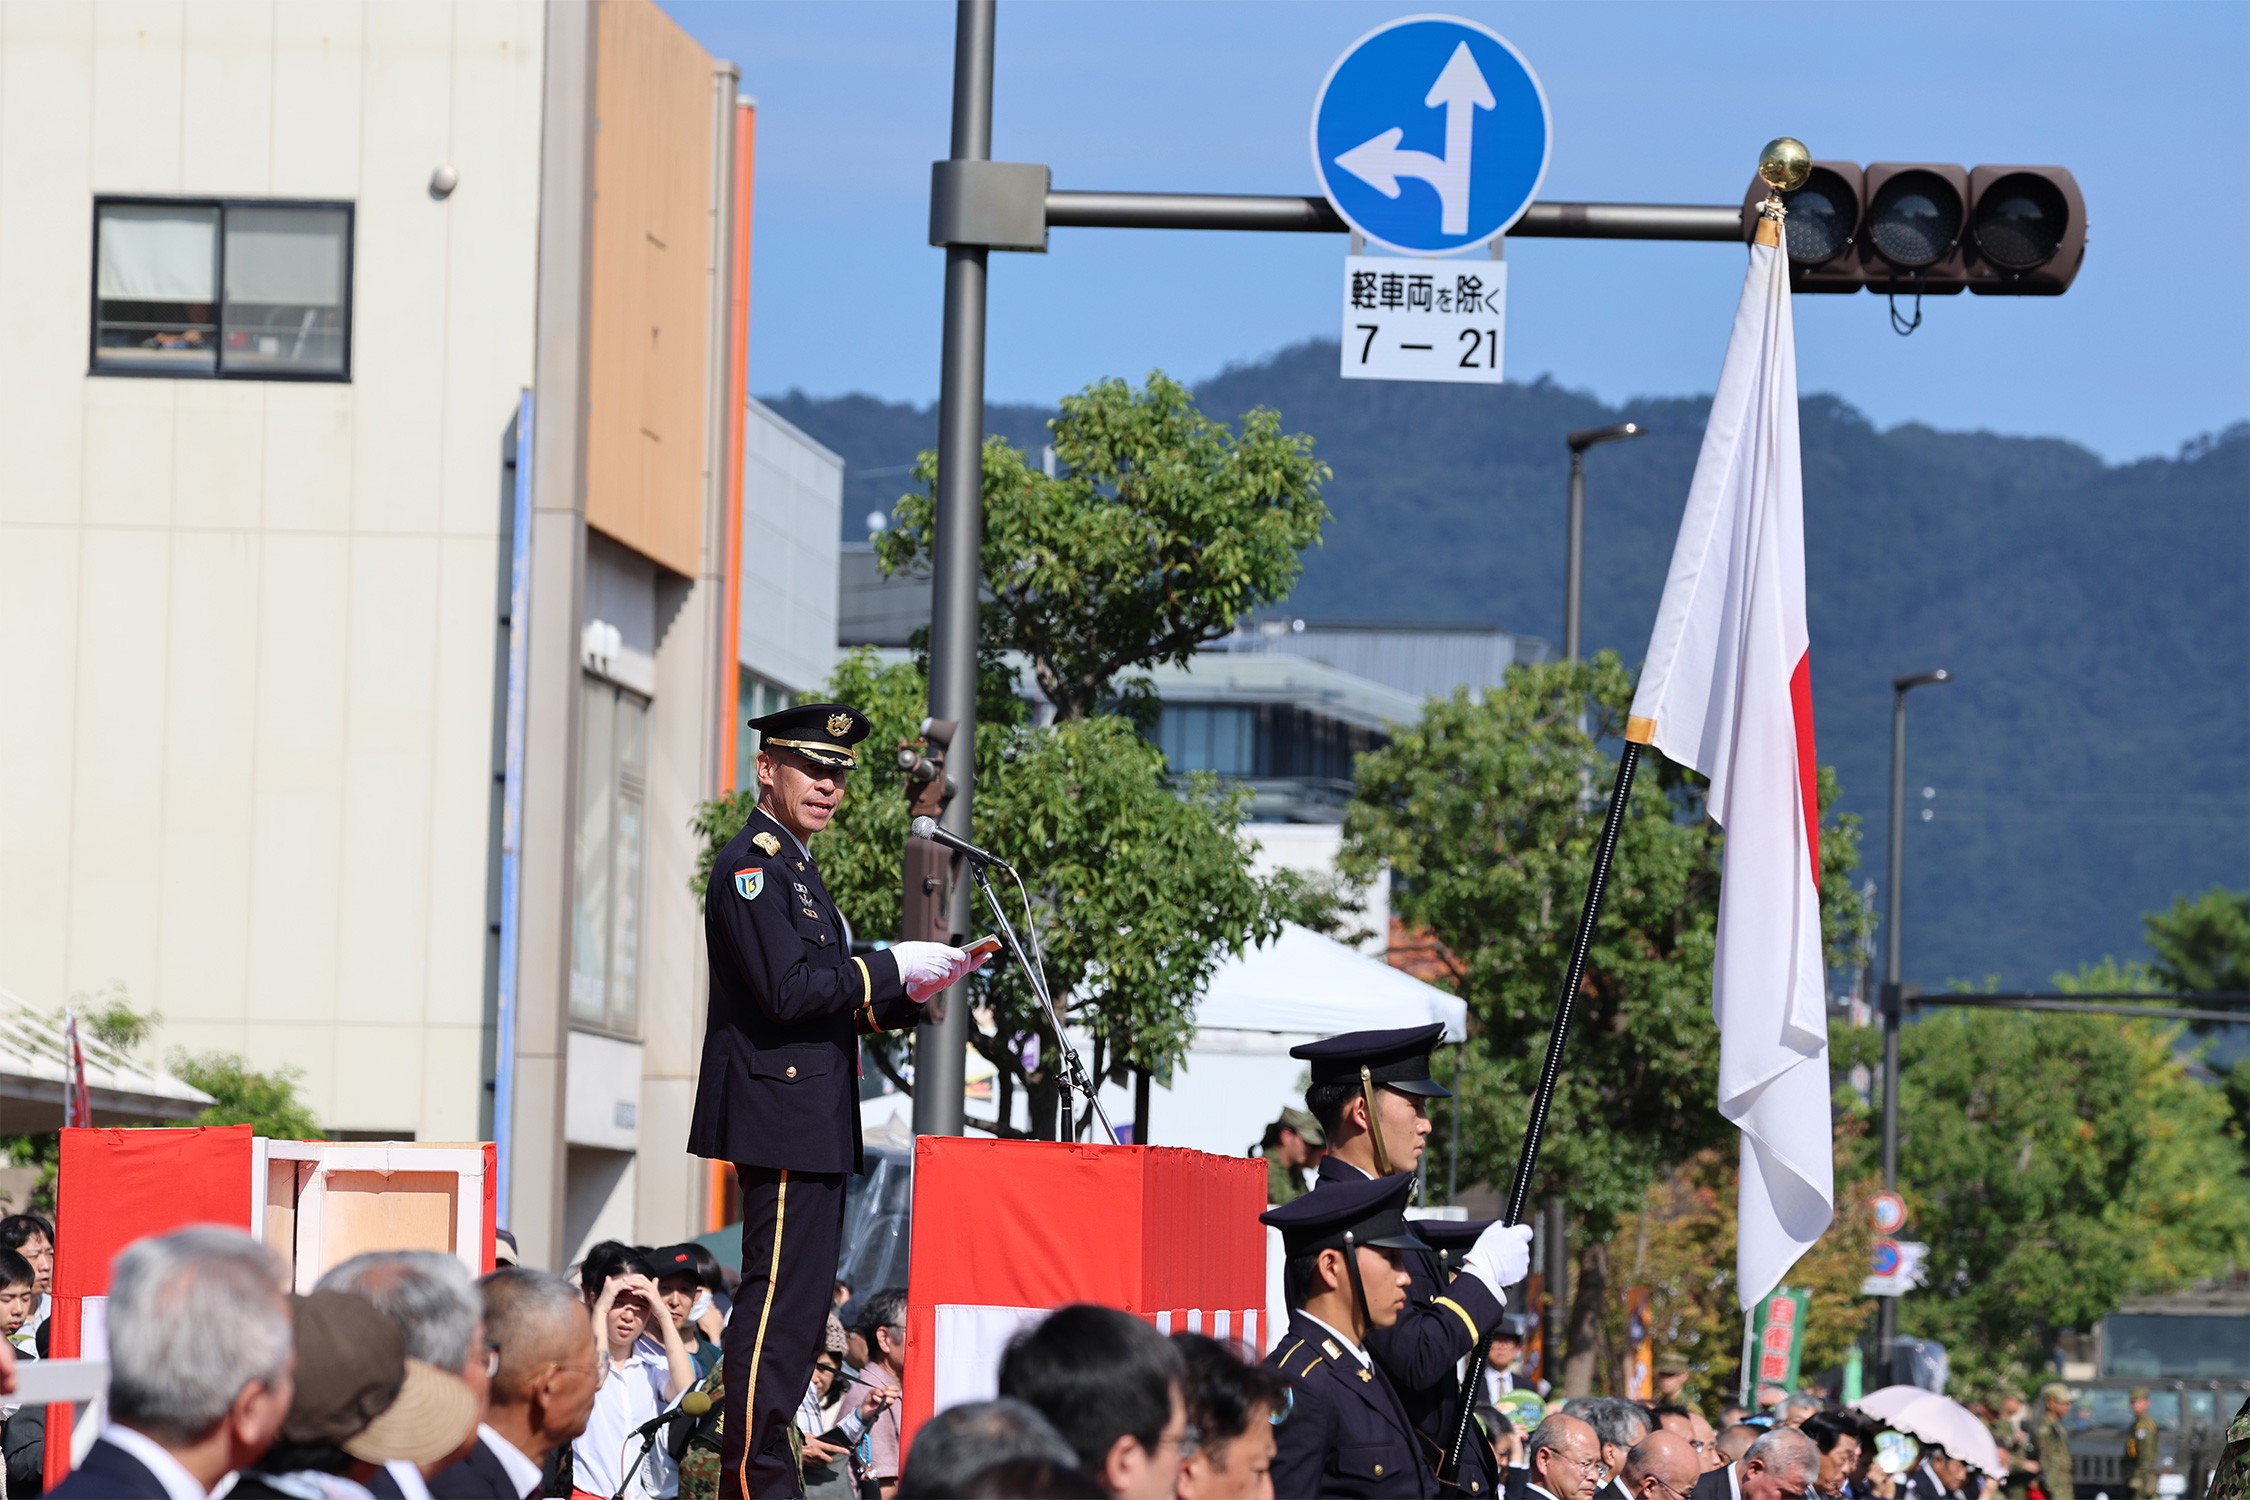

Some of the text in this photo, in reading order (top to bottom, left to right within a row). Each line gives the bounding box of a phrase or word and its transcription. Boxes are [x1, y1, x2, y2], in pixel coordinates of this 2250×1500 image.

[1351, 270, 1499, 314] 軽車両を除く
[1356, 324, 1379, 364] 7
[1459, 328, 1497, 368] 21
[1756, 1295, 1796, 1402] 自衛隊
